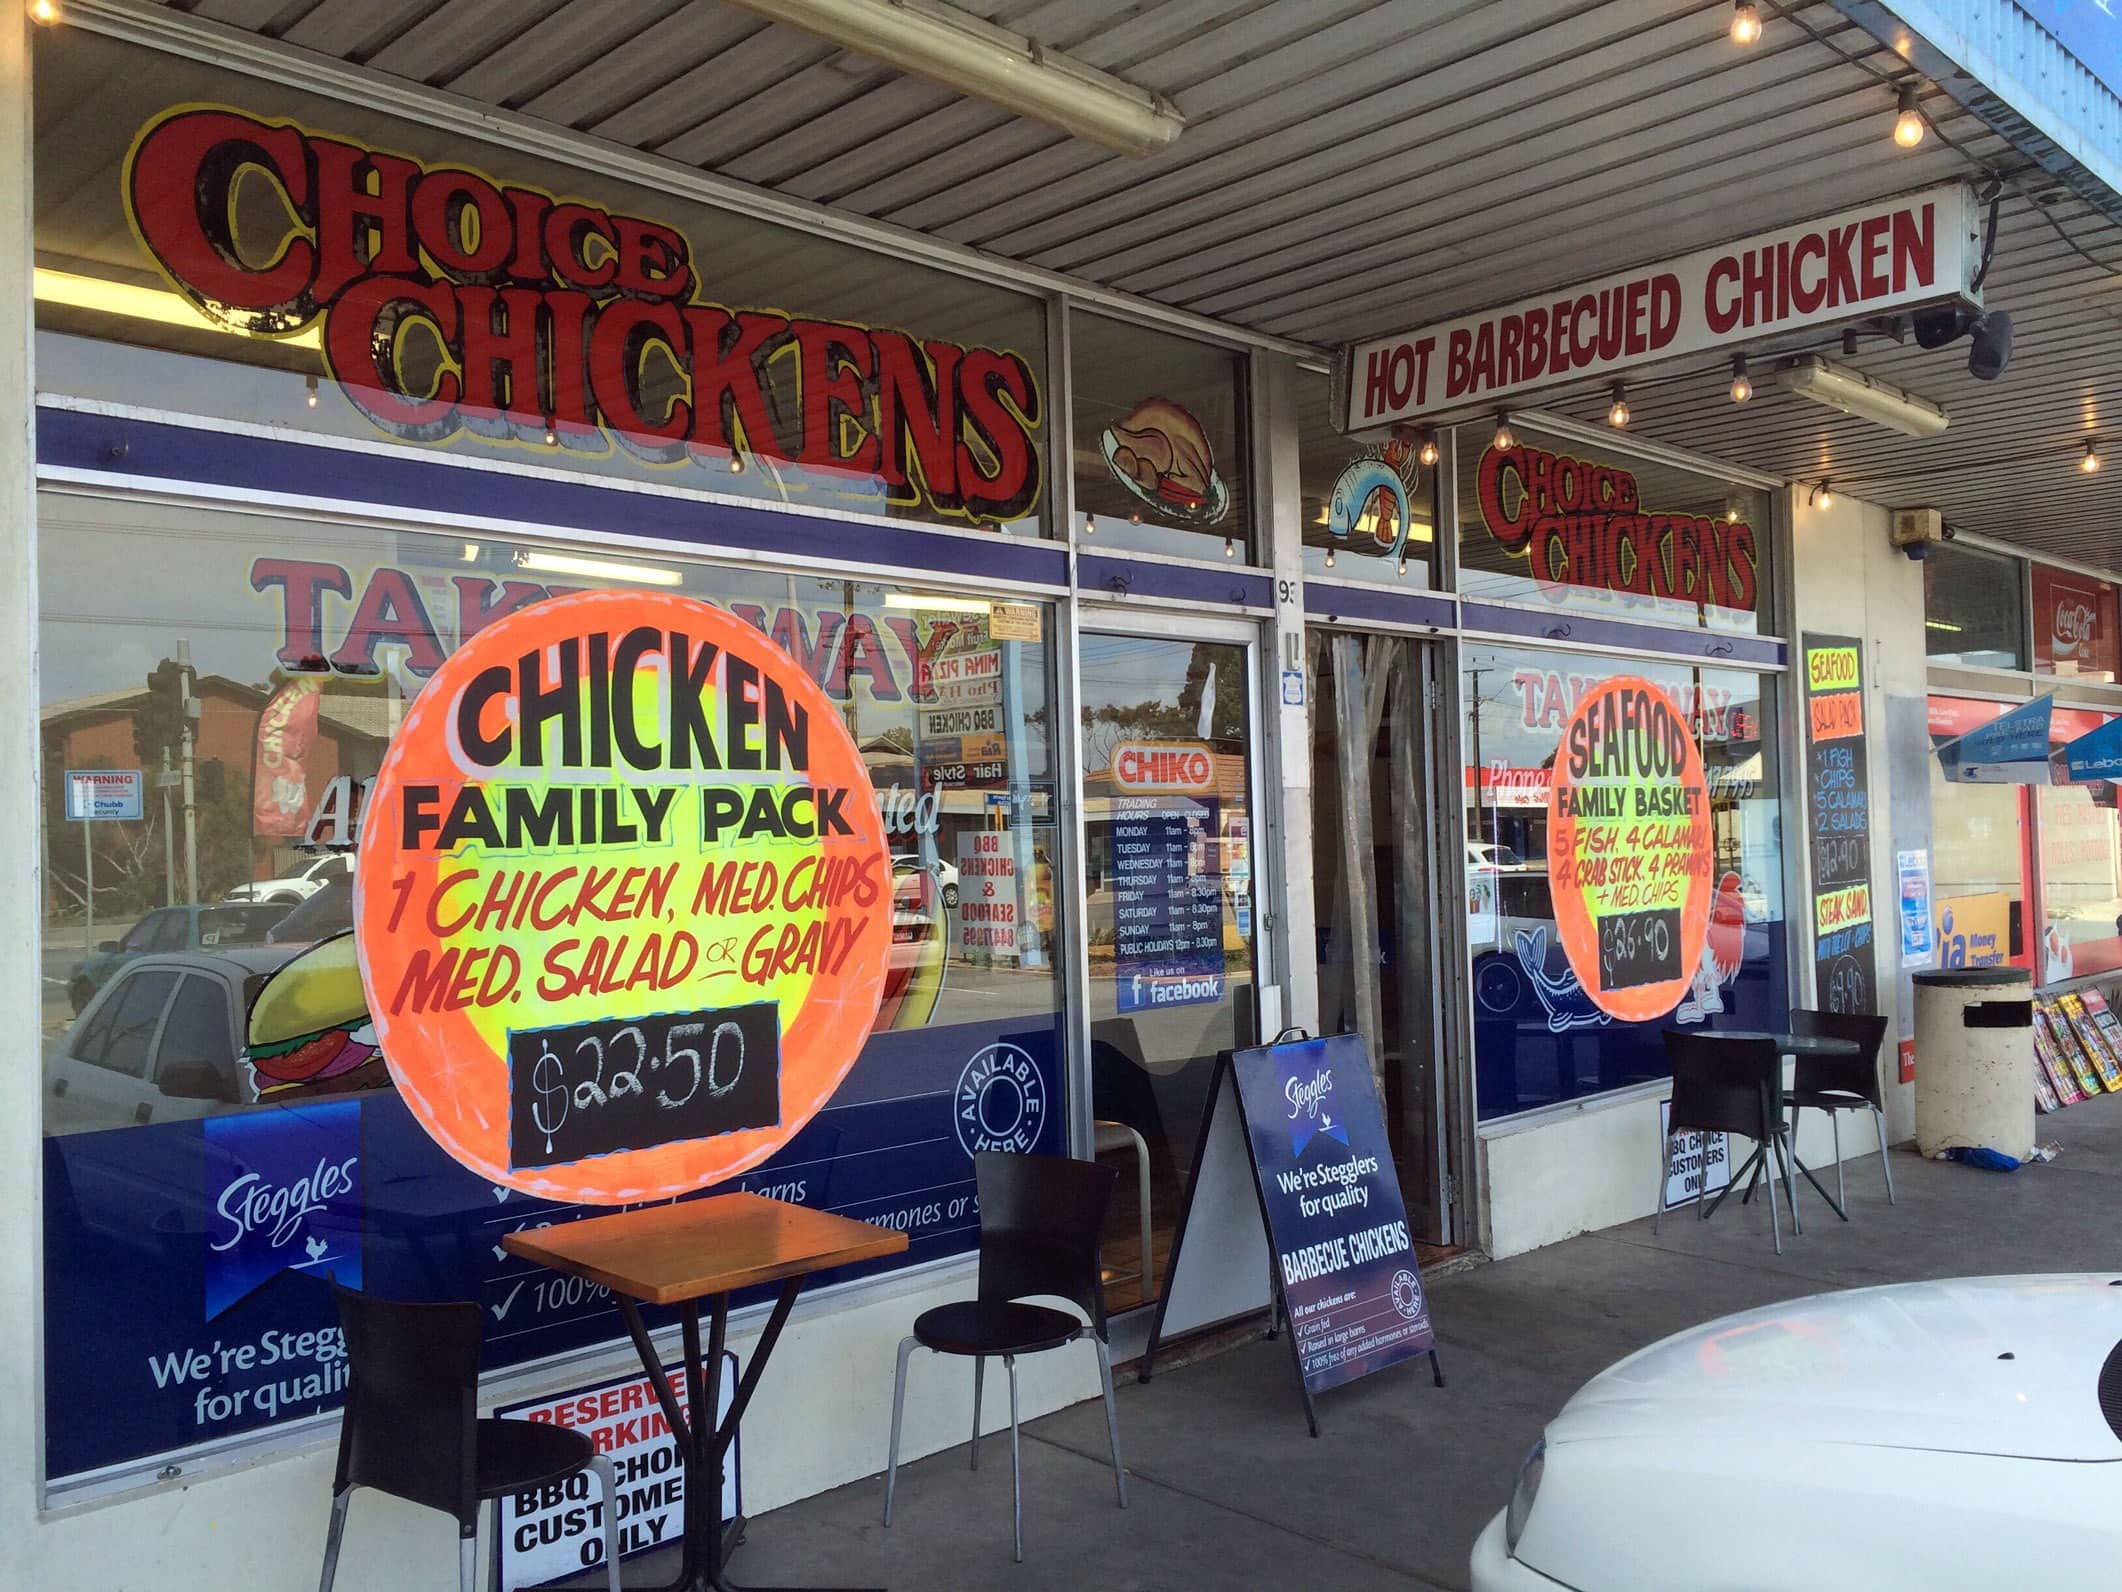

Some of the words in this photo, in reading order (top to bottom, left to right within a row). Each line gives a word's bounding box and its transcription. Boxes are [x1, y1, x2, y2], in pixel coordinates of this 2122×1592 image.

[124, 105, 695, 335] CHOICE
[1364, 337, 1435, 417] HOT
[1447, 273, 1682, 398] BARBECUED
[1706, 203, 1936, 334] CHICKEN
[322, 272, 1045, 518] CHICKENS
[1478, 443, 1640, 552] CHOICE
[1530, 510, 1757, 615] CHICKENS
[1811, 652, 1855, 684] SEAFOOD
[457, 626, 808, 771] CHICKEN
[1569, 688, 1686, 778] SEAFOOD
[1119, 750, 1209, 784] CHIKO
[1487, 758, 1545, 798] Phone
[1820, 769, 1856, 789] CHIPS
[1117, 810, 1150, 820] HOURS
[1161, 810, 1180, 820] OPEN
[1118, 799, 1157, 810] TRADING
[1558, 787, 1627, 817] FAMILY
[1636, 786, 1701, 817] BASKET
[1816, 792, 1827, 809] 5
[402, 786, 677, 850] FAMILY
[704, 788, 854, 842] PACK
[1116, 826, 1148, 837] MONDAY
[1165, 826, 1182, 836] 11am
[1818, 813, 1828, 831] 2
[1117, 843, 1151, 853] TUESDAY
[1166, 842, 1183, 852] 11am
[1555, 830, 1570, 856] 5
[1626, 824, 1640, 850] 4
[1117, 859, 1163, 870] WEDNESDAY
[1119, 875, 1157, 886] THURSDAY
[1167, 874, 1184, 884] 11am
[1556, 859, 1571, 889] 4
[1575, 856, 1608, 889] CRAB
[1649, 854, 1660, 880] 4
[386, 872, 415, 932] 1
[426, 862, 678, 937] CHICKEN,
[691, 861, 776, 915] MED.
[782, 852, 881, 912] CHIPS
[1118, 891, 1144, 901] FRIDAY
[1168, 890, 1184, 899] 11am
[1641, 880, 1680, 905] CHIPS
[1119, 907, 1157, 919] SATURDAY
[1168, 906, 1185, 916] 11am
[1820, 895, 1844, 927] STEAK
[1119, 925, 1150, 937] SUNDAY
[1169, 923, 1185, 933] 11am
[1192, 921, 1208, 932] 8pm
[1969, 933, 1997, 949] Money
[1120, 942, 1143, 955] PUBLIC
[1144, 939, 1174, 953] HOLIDAYS
[1970, 951, 2004, 966] Transfer
[390, 945, 520, 1016] MED.
[536, 931, 699, 1002] SALAD
[706, 937, 738, 963] OR
[740, 916, 868, 986] GRAVY
[1149, 967, 1165, 977] Like
[1165, 968, 1175, 976] us
[1176, 967, 1185, 975] on
[1150, 975, 1218, 1004] facebook
[532, 1021, 745, 1154] $22.50
[961, 1053, 1040, 1121] AVAILABLE
[1285, 1069, 1334, 1119] Steggles
[974, 1127, 1029, 1153] HERE
[1672, 1138, 1686, 1155] BQ
[1689, 1131, 1723, 1151] CHICE
[1276, 1165, 1318, 1195] We're
[1317, 1154, 1379, 1186] Stegglers
[210, 1157, 358, 1251] Steggles
[948, 1198, 968, 1220] or
[1299, 1194, 1323, 1218] for
[1322, 1185, 1369, 1217] quality
[1281, 1235, 1350, 1286] BARBECUE
[1348, 1220, 1410, 1265] CHICKENS
[1294, 1304, 1304, 1318] All
[1304, 1305, 1316, 1314] our
[1316, 1295, 1343, 1311] chickens
[1303, 1323, 1321, 1335] Grain
[1320, 1316, 1331, 1333] fed
[1308, 1338, 1328, 1352] Raised
[1327, 1334, 1334, 1345] in
[1334, 1330, 1349, 1344] large
[1349, 1325, 1366, 1338] barns
[149, 1339, 257, 1390] We're
[260, 1326, 348, 1366] Stegg
[1311, 1355, 1329, 1369] 100%
[1328, 1351, 1341, 1368] free
[1340, 1347, 1348, 1361] of
[1346, 1346, 1358, 1359] any
[1358, 1338, 1376, 1353] added
[1375, 1329, 1402, 1346] hormones
[1401, 1327, 1408, 1337] or
[194, 1386, 249, 1425] for
[253, 1360, 350, 1417] qualit
[529, 1366, 707, 1429] RESERVE
[589, 1403, 692, 1456] RKING
[514, 1471, 590, 1519] BBQ
[613, 1443, 686, 1489] CHOI
